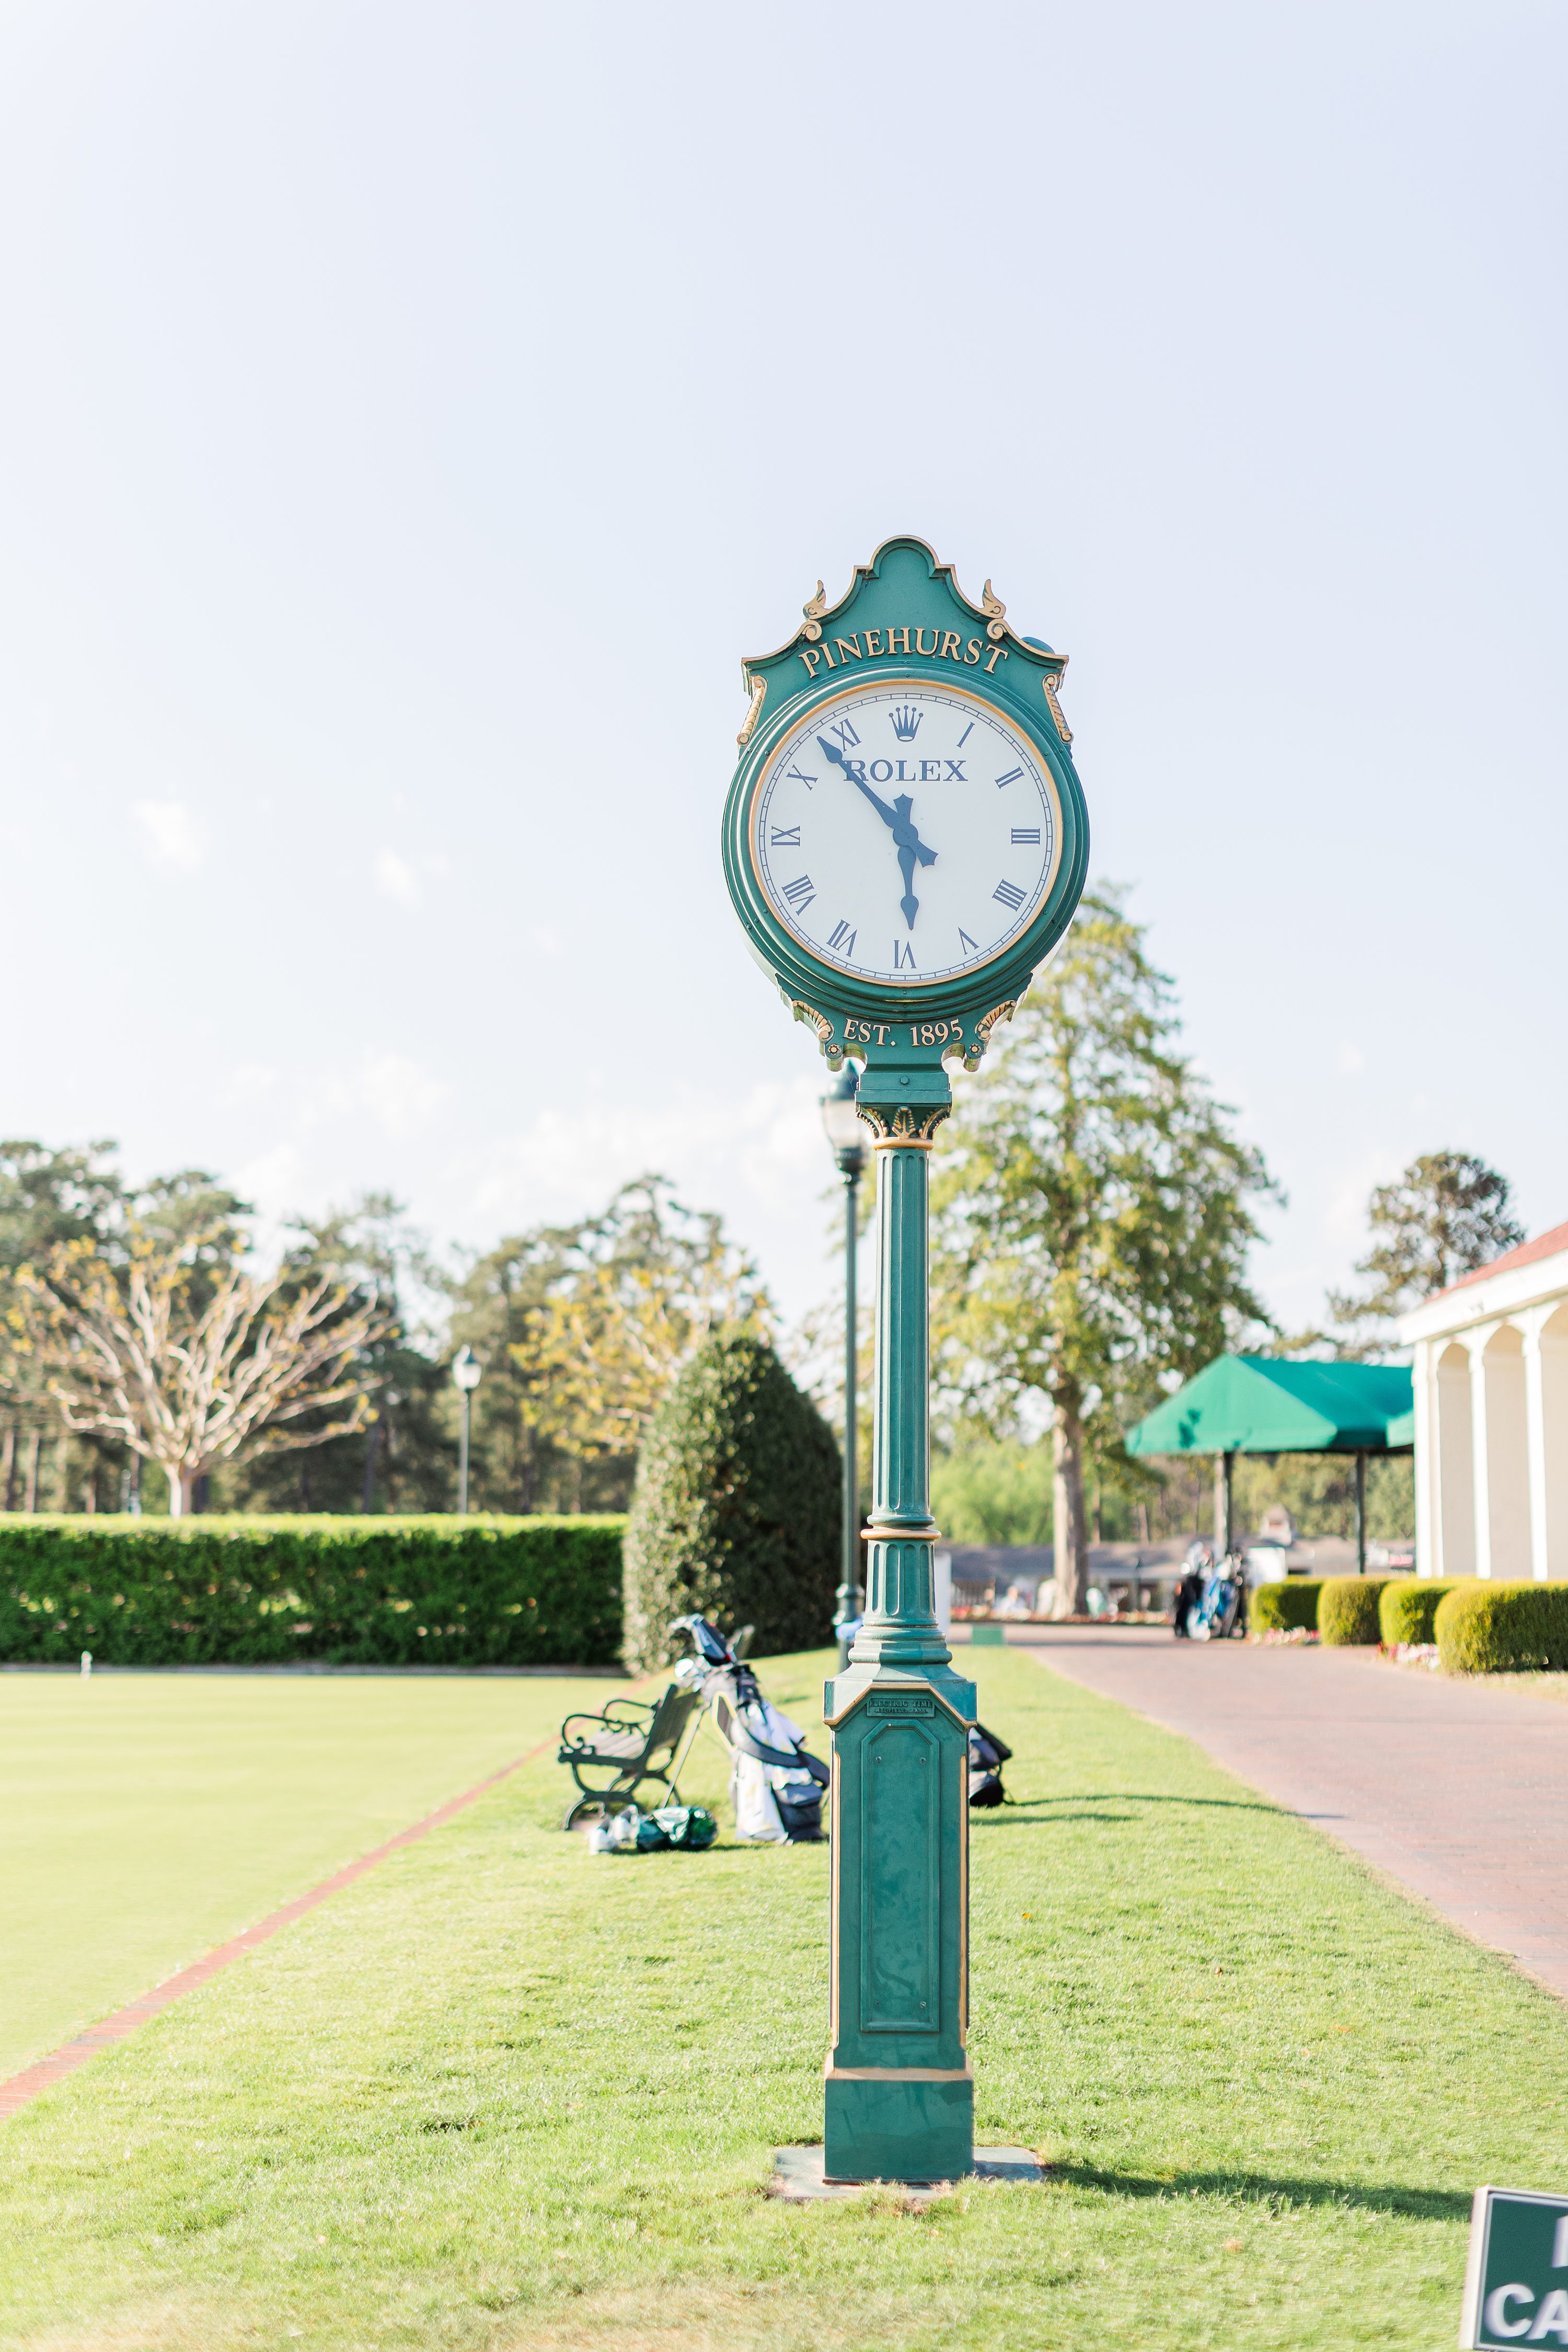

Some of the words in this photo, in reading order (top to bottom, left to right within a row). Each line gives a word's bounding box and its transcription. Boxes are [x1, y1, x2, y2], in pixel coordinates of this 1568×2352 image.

[798, 627, 1008, 678] PINEHURST
[829, 718, 862, 752] XI
[786, 764, 818, 790] X
[843, 759, 968, 782] ROLEX
[995, 766, 1024, 789] II
[771, 825, 801, 847] IX
[1011, 828, 1041, 845] III
[781, 874, 817, 916] VIII
[991, 879, 1028, 912] IIII
[826, 919, 857, 957] VII
[958, 927, 979, 955] V
[893, 940, 917, 969] VI
[843, 1019, 896, 1046] EST.
[910, 1019, 964, 1046] 1895
